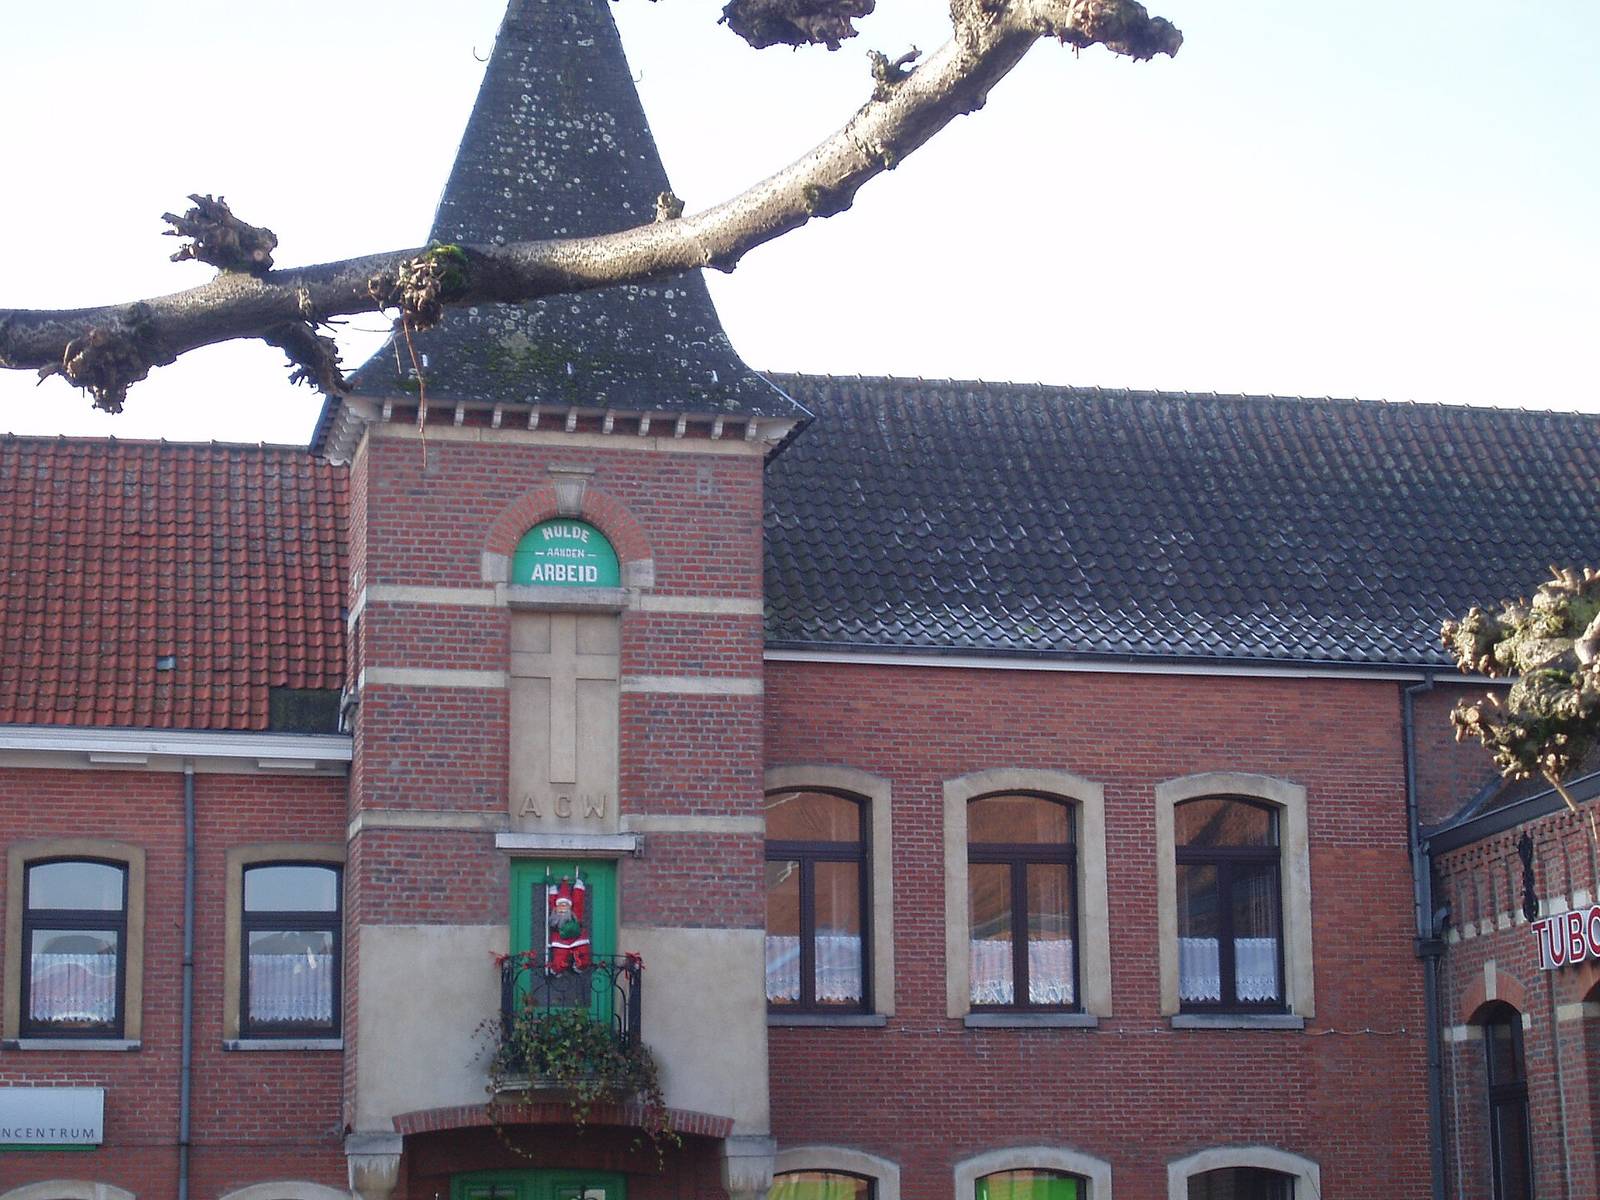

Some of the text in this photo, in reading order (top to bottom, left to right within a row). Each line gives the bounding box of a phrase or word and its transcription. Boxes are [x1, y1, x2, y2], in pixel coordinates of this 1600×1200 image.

[542, 525, 590, 544] HULDE
[531, 563, 598, 583] ARBEID
[2, 1127, 95, 1139] NCENTRUM
